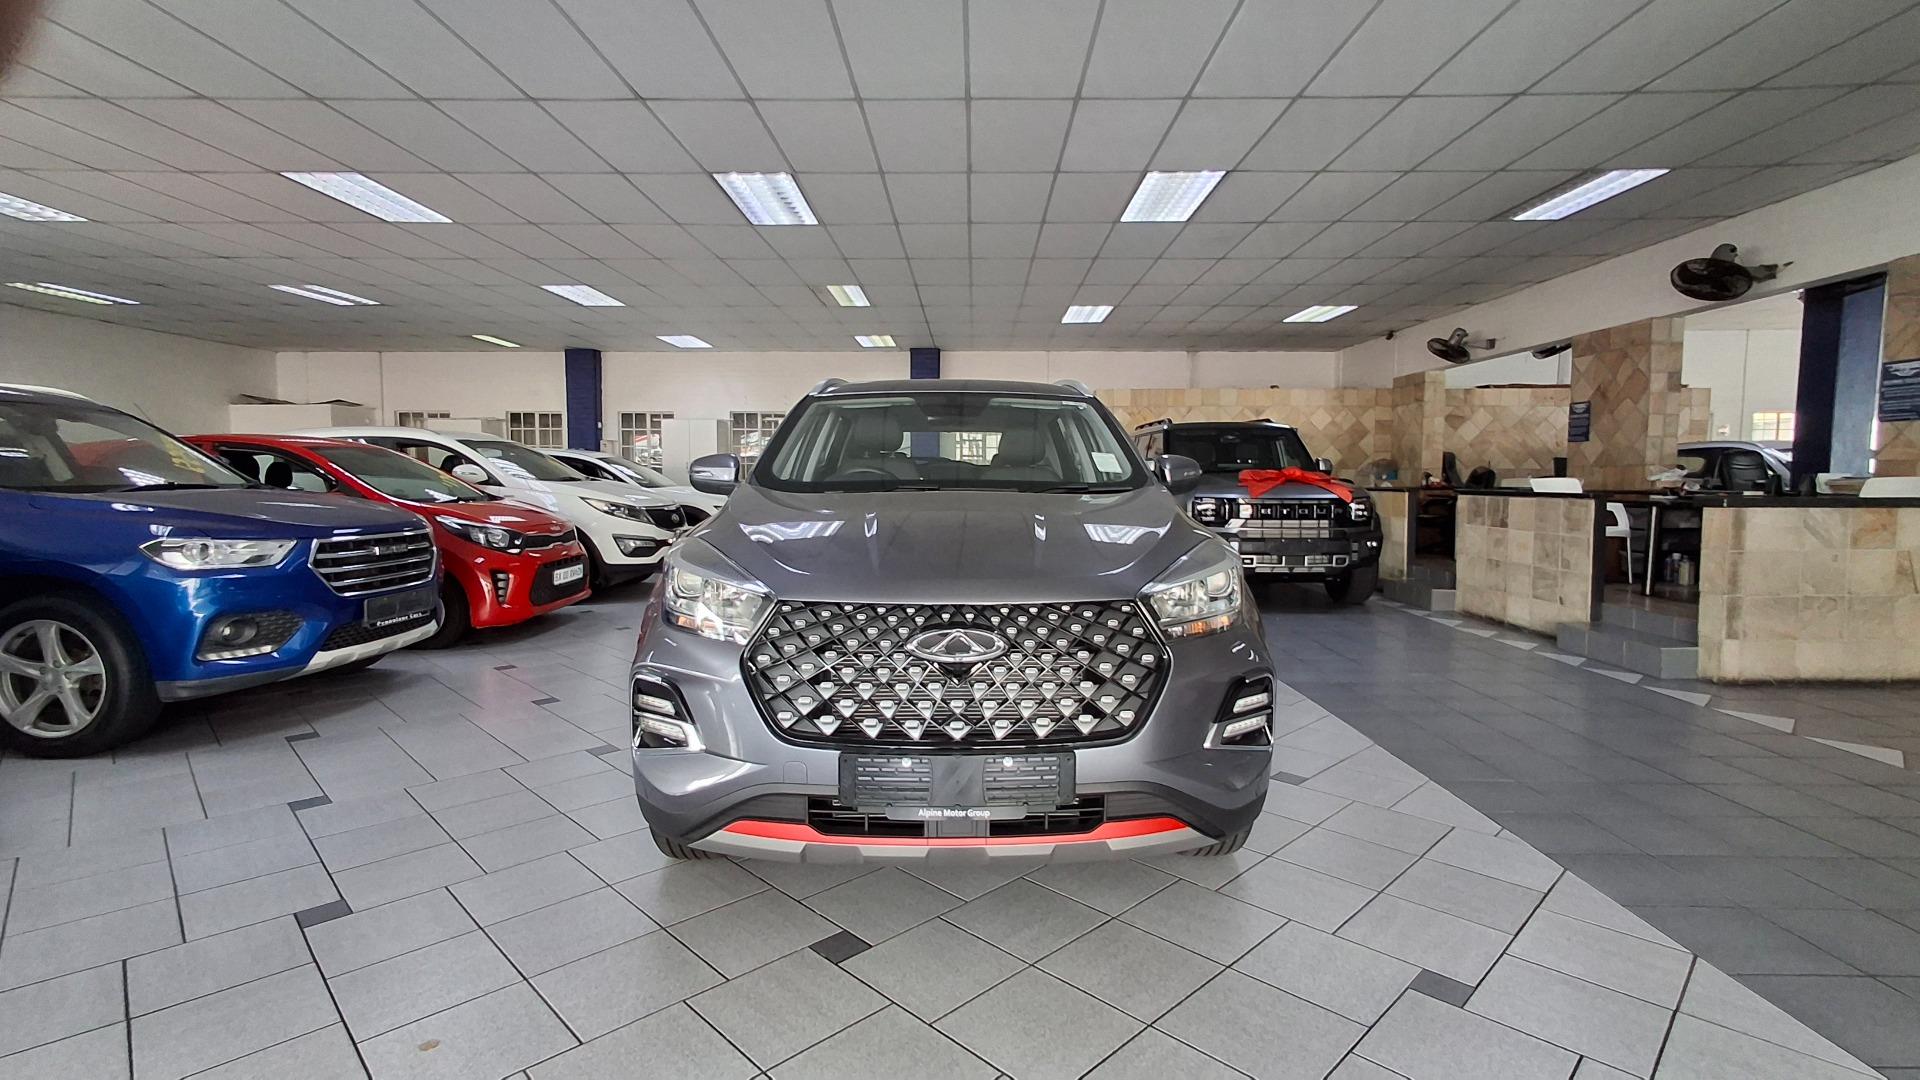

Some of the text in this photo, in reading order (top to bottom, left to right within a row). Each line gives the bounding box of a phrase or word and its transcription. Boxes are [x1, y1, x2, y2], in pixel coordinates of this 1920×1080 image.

[918, 808, 991, 818] Alpine Motor Group
